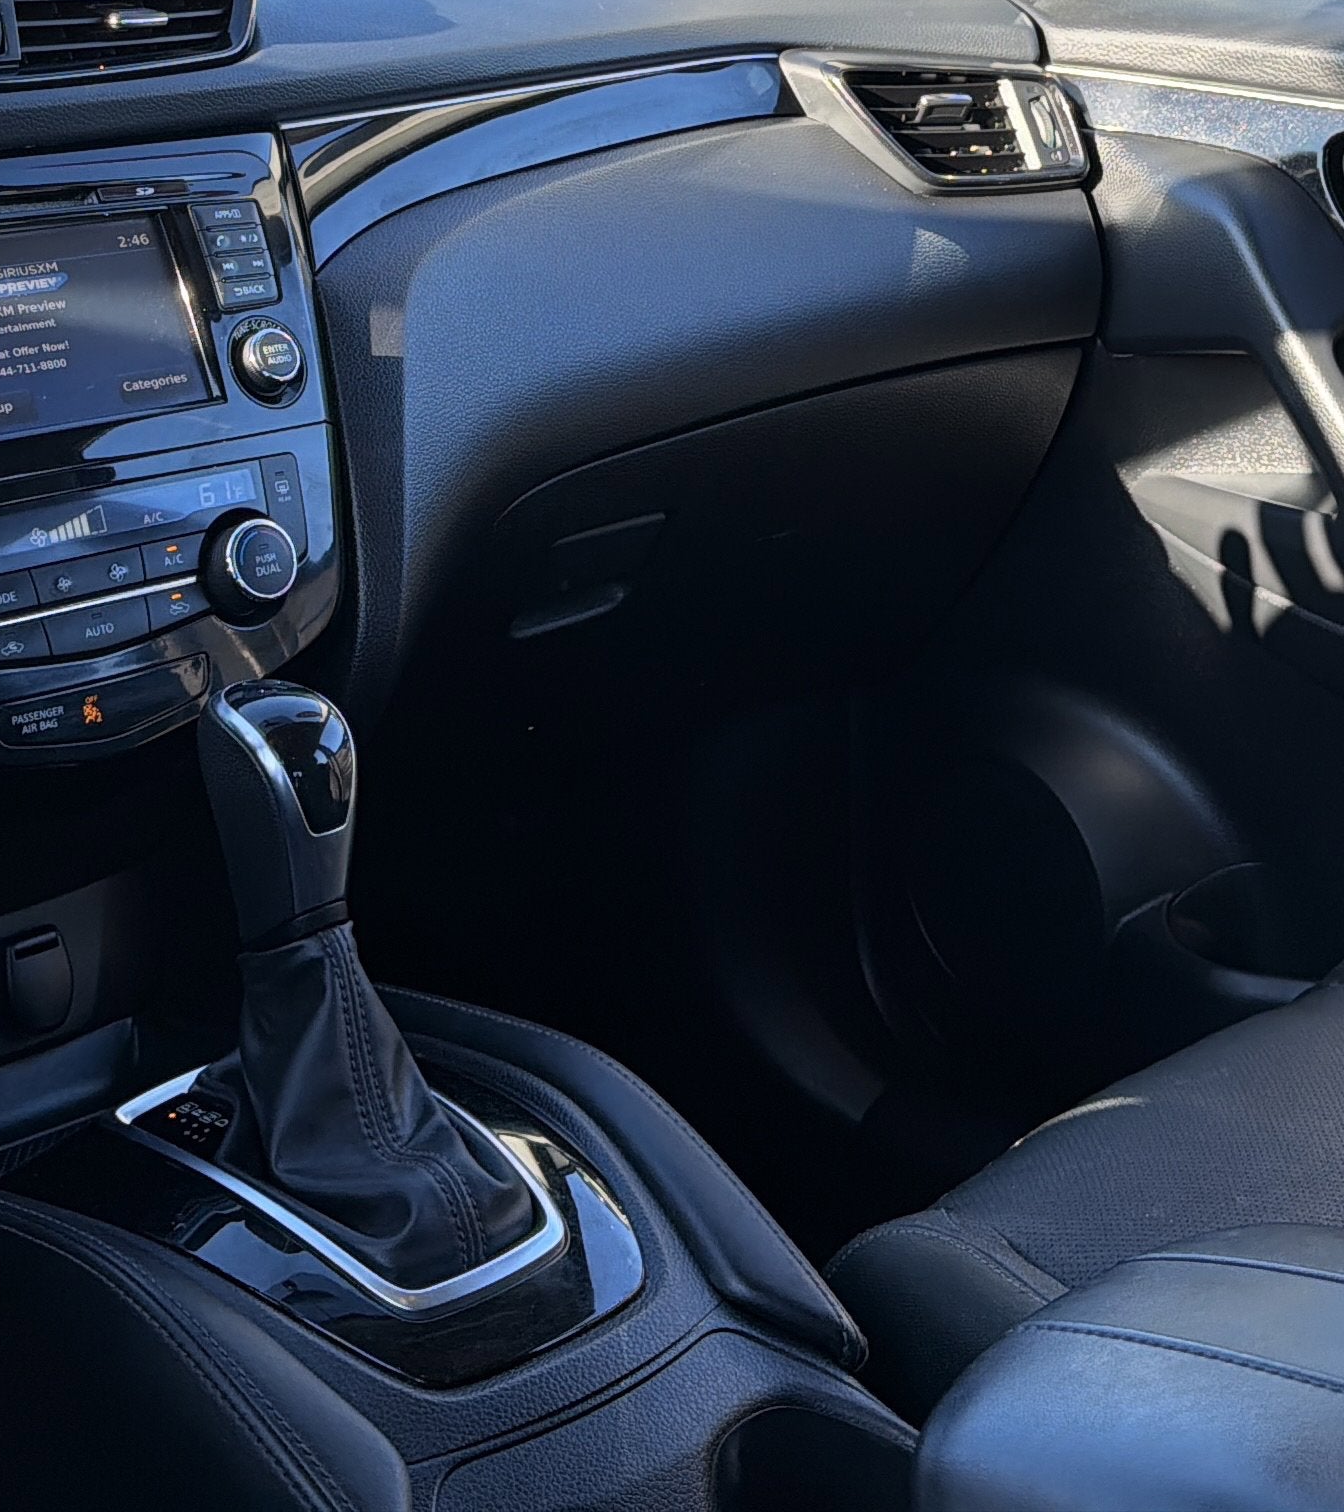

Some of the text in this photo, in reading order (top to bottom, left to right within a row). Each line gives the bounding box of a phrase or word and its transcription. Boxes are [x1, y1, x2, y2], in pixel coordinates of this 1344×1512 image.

[117, 233, 150, 248] 2:46
[242, 284, 265, 296] BACK
[17, 299, 67, 316] Preview
[12, 345, 40, 358] Offer
[42, 340, 70, 354] Now!
[262, 343, 289, 355] ENTER
[268, 354, 292, 366] AUDIO
[122, 373, 188, 392] Categories
[143, 511, 164, 525] A/C
[164, 553, 184, 566] A/C
[255, 552, 277, 565] PUSH
[255, 563, 282, 578] DUAL
[85, 622, 115, 639] AUTO
[11, 705, 65, 726] PASSENGER
[21, 719, 59, 735] AIR BAG
